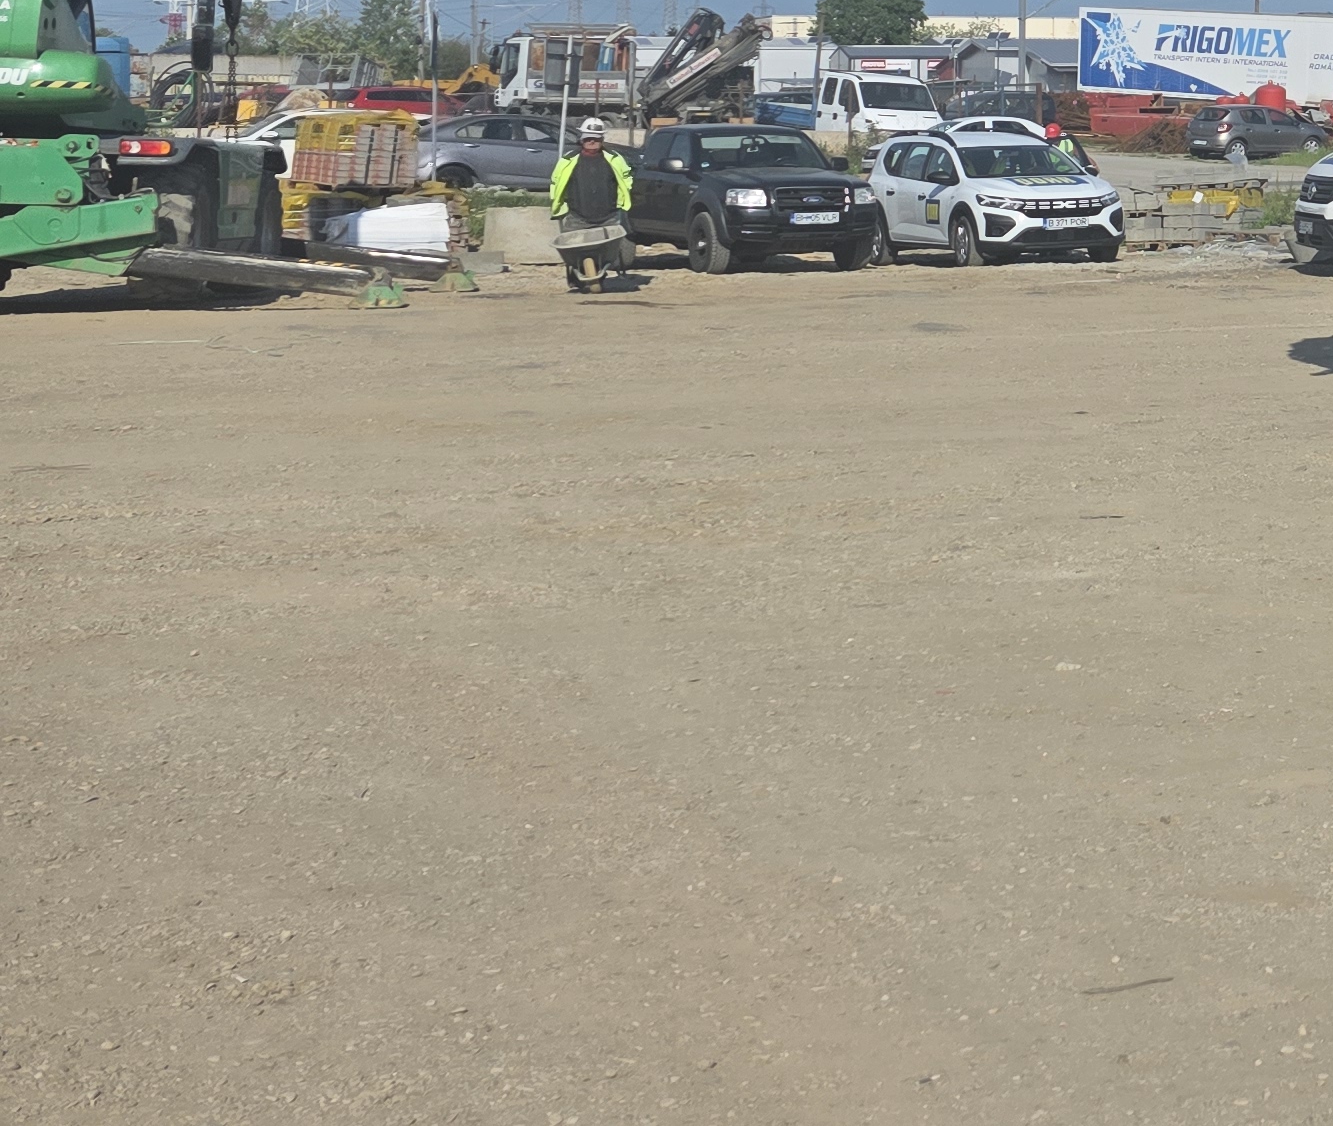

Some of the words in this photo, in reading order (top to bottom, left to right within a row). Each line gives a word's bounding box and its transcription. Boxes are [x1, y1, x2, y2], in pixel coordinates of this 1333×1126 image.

[1155, 24, 1291, 58] FRIGOMEX
[1154, 54, 1193, 62] TRANSPORT
[1233, 59, 1288, 67] INTERNATIONAL
